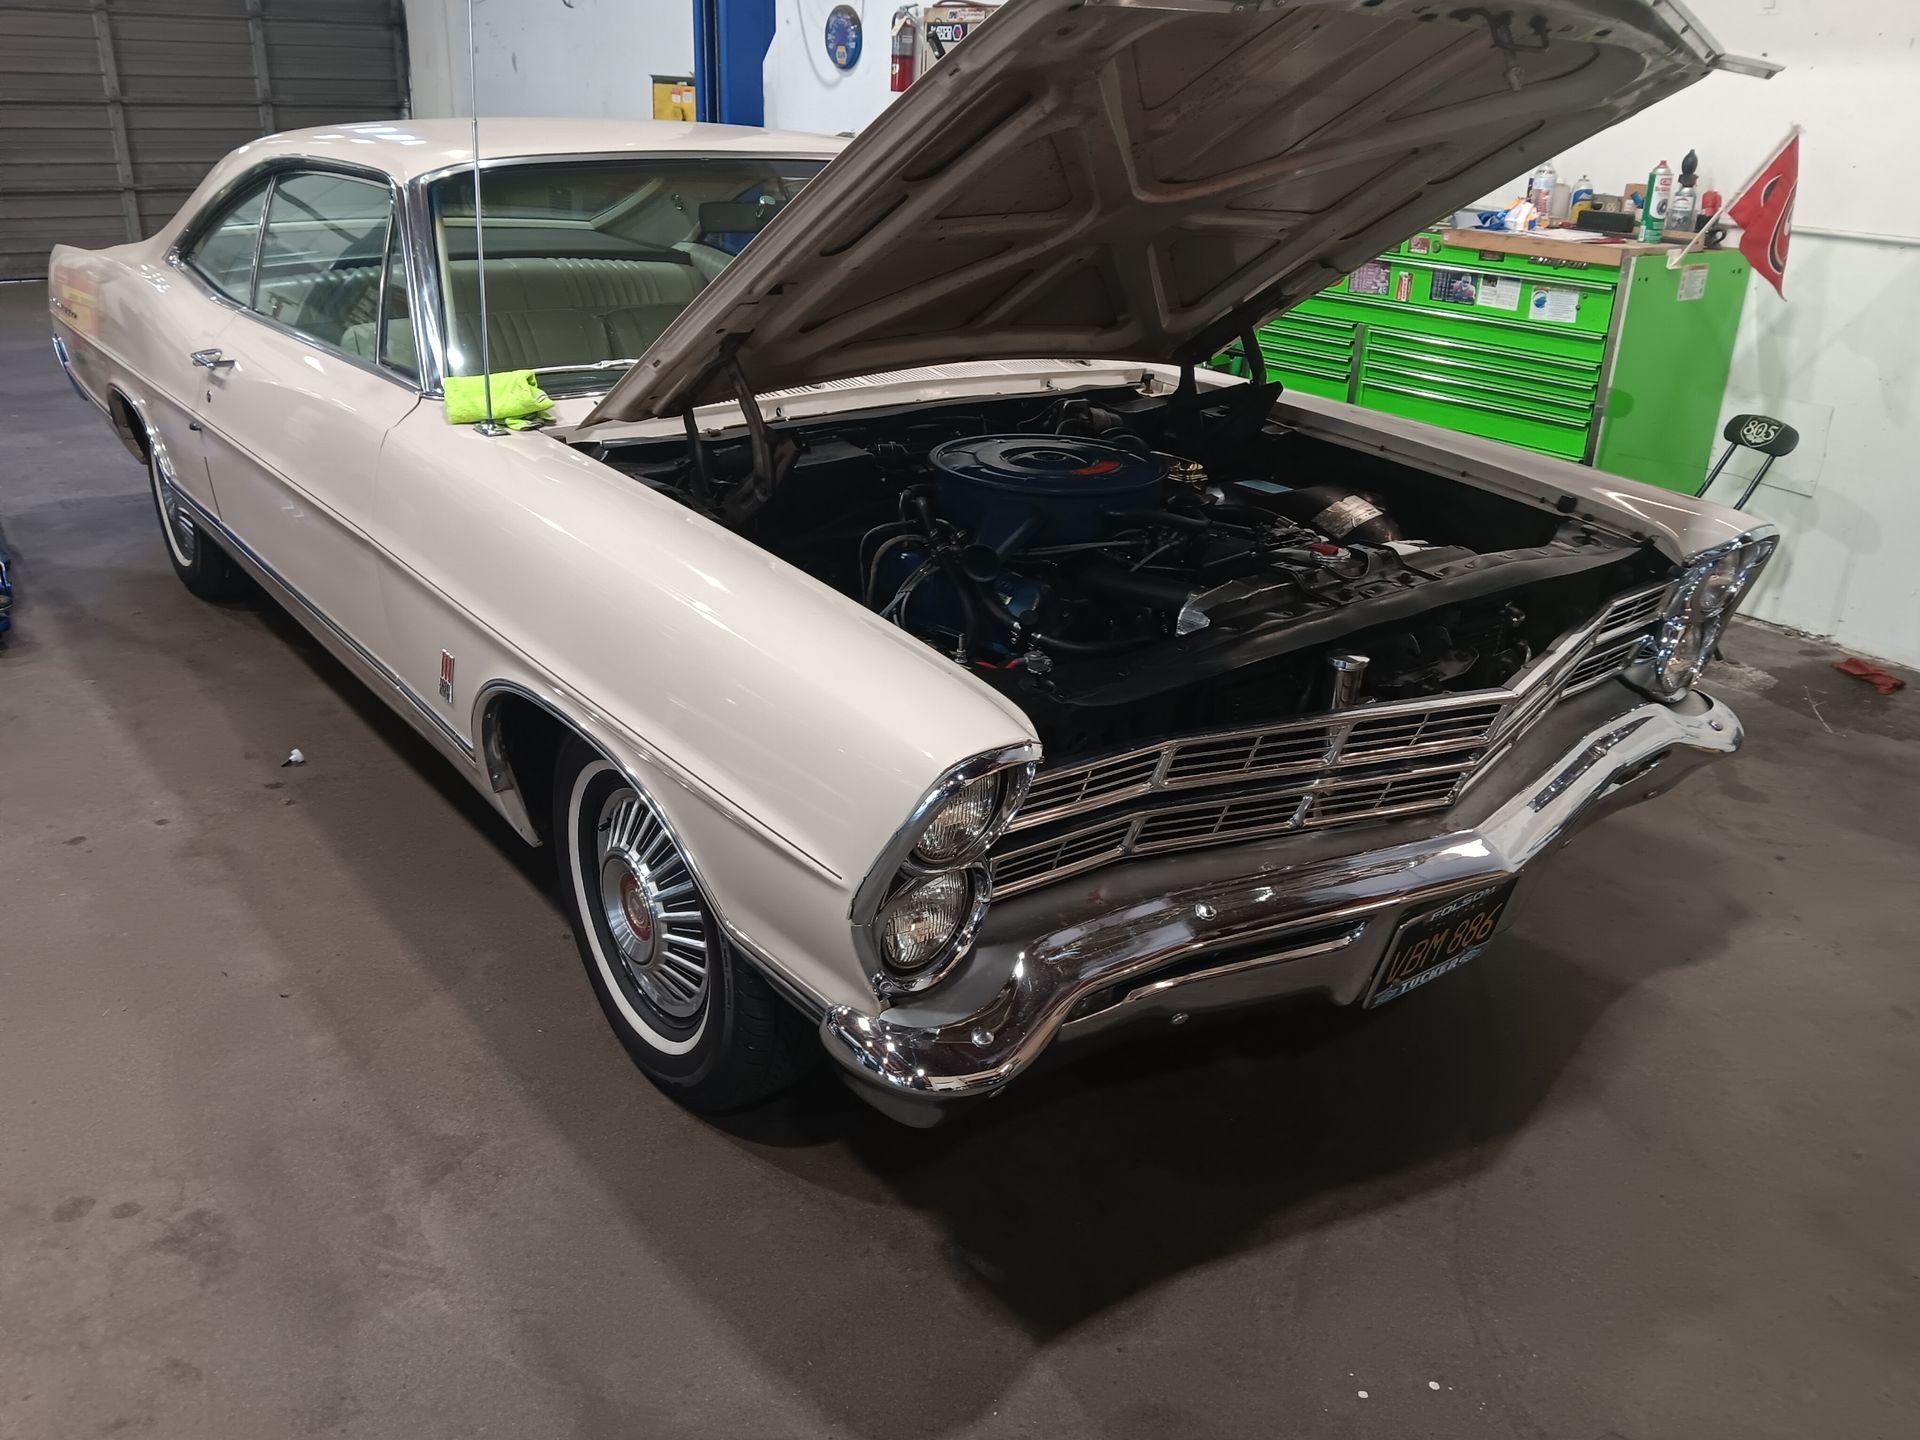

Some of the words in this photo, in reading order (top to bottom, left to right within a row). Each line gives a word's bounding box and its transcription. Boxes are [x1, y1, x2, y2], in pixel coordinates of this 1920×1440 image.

[1743, 420, 1779, 440] 805
[1429, 886, 1496, 921] FOLSOM
[1386, 928, 1449, 984] VBM
[1447, 903, 1503, 954] 886
[1400, 957, 1458, 993] TUCKER
